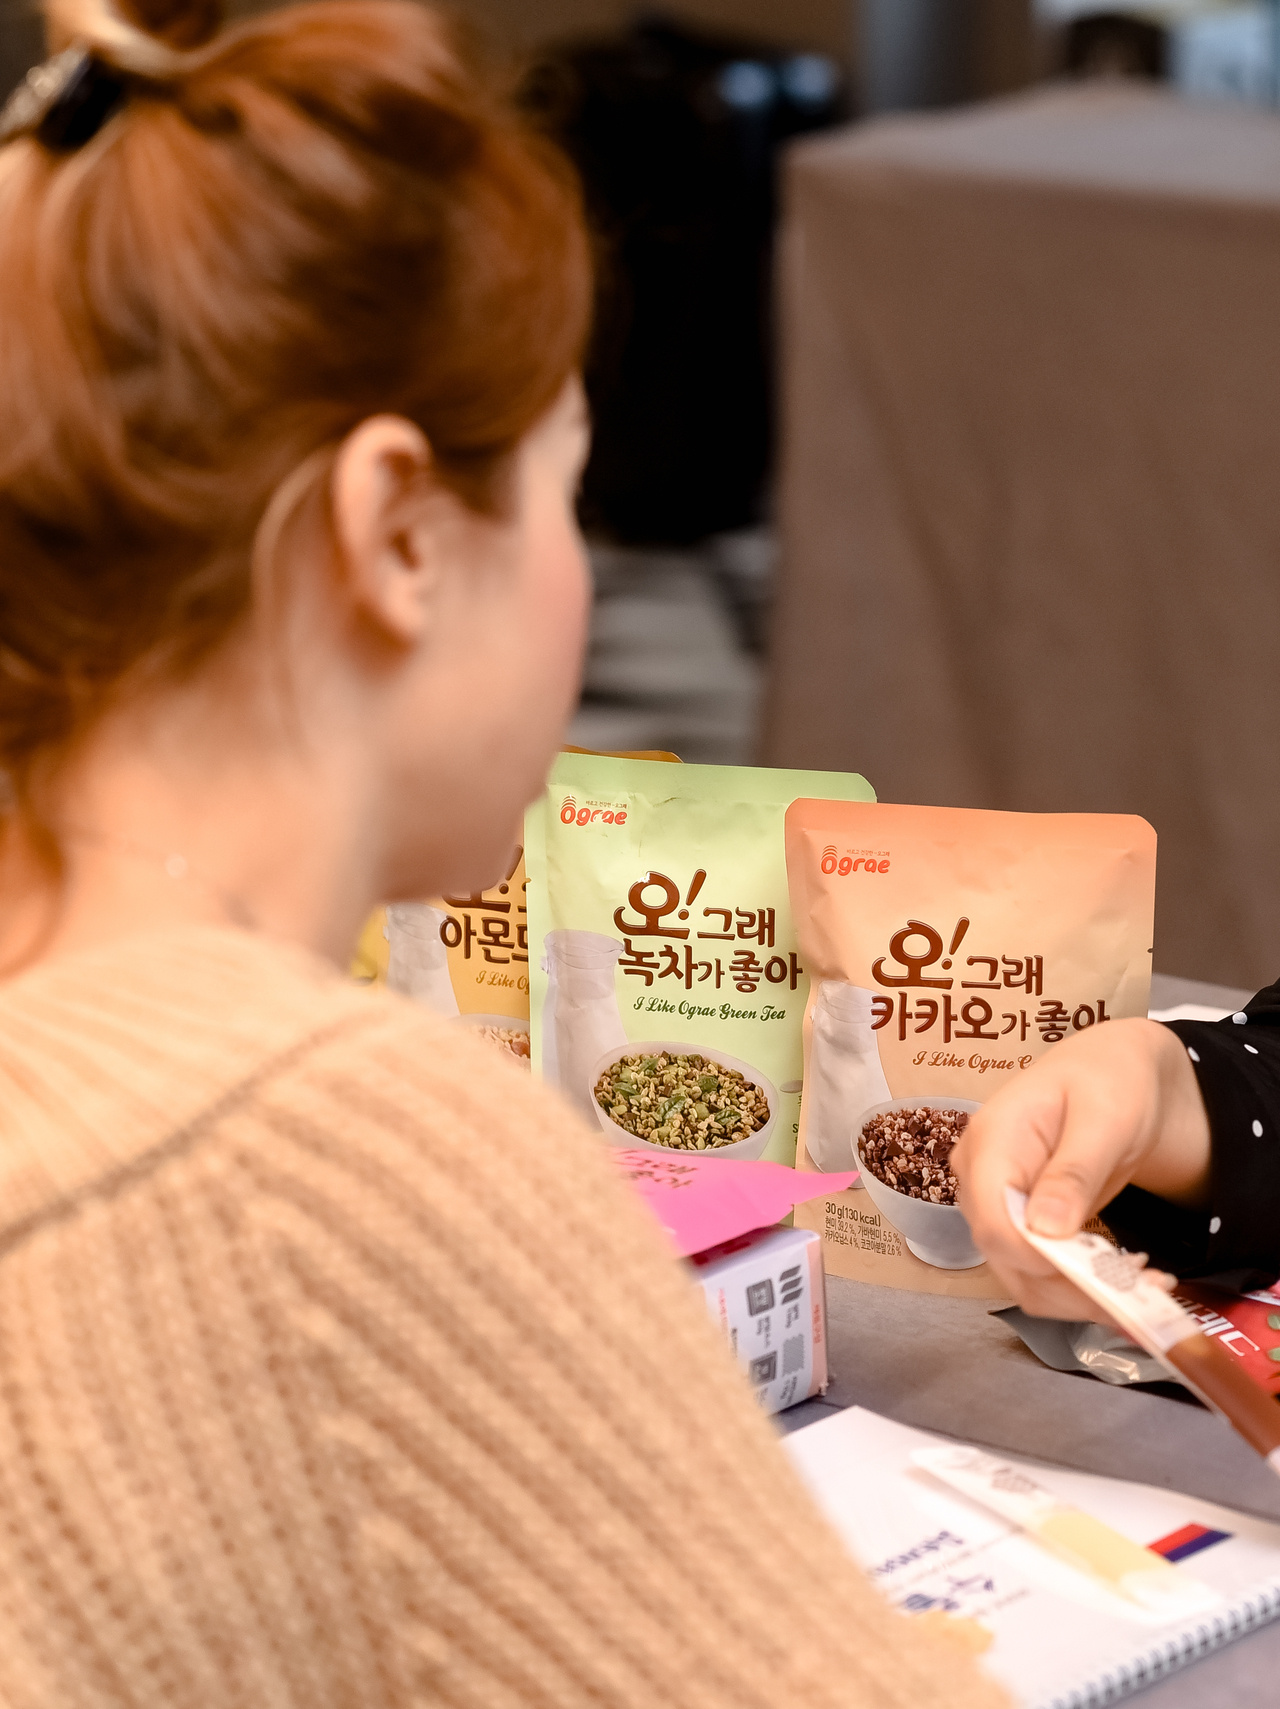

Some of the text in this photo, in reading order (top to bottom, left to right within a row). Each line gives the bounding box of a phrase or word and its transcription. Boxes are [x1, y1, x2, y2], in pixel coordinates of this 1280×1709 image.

[560, 806, 628, 827] Ograe
[820, 856, 891, 877] Ograe
[613, 868, 776, 949] 오! 그래
[871, 917, 1044, 996] 오! 그래
[476, 970, 487, 984] I
[487, 971, 515, 988] Like
[633, 996, 787, 1022] I Like Ograe Green Tea
[912, 1051, 928, 1066] I
[928, 1051, 965, 1068] Like
[968, 1053, 1015, 1074] Ograe
[825, 1201, 836, 1215] 30
[860, 1211, 881, 1227] kcal)
